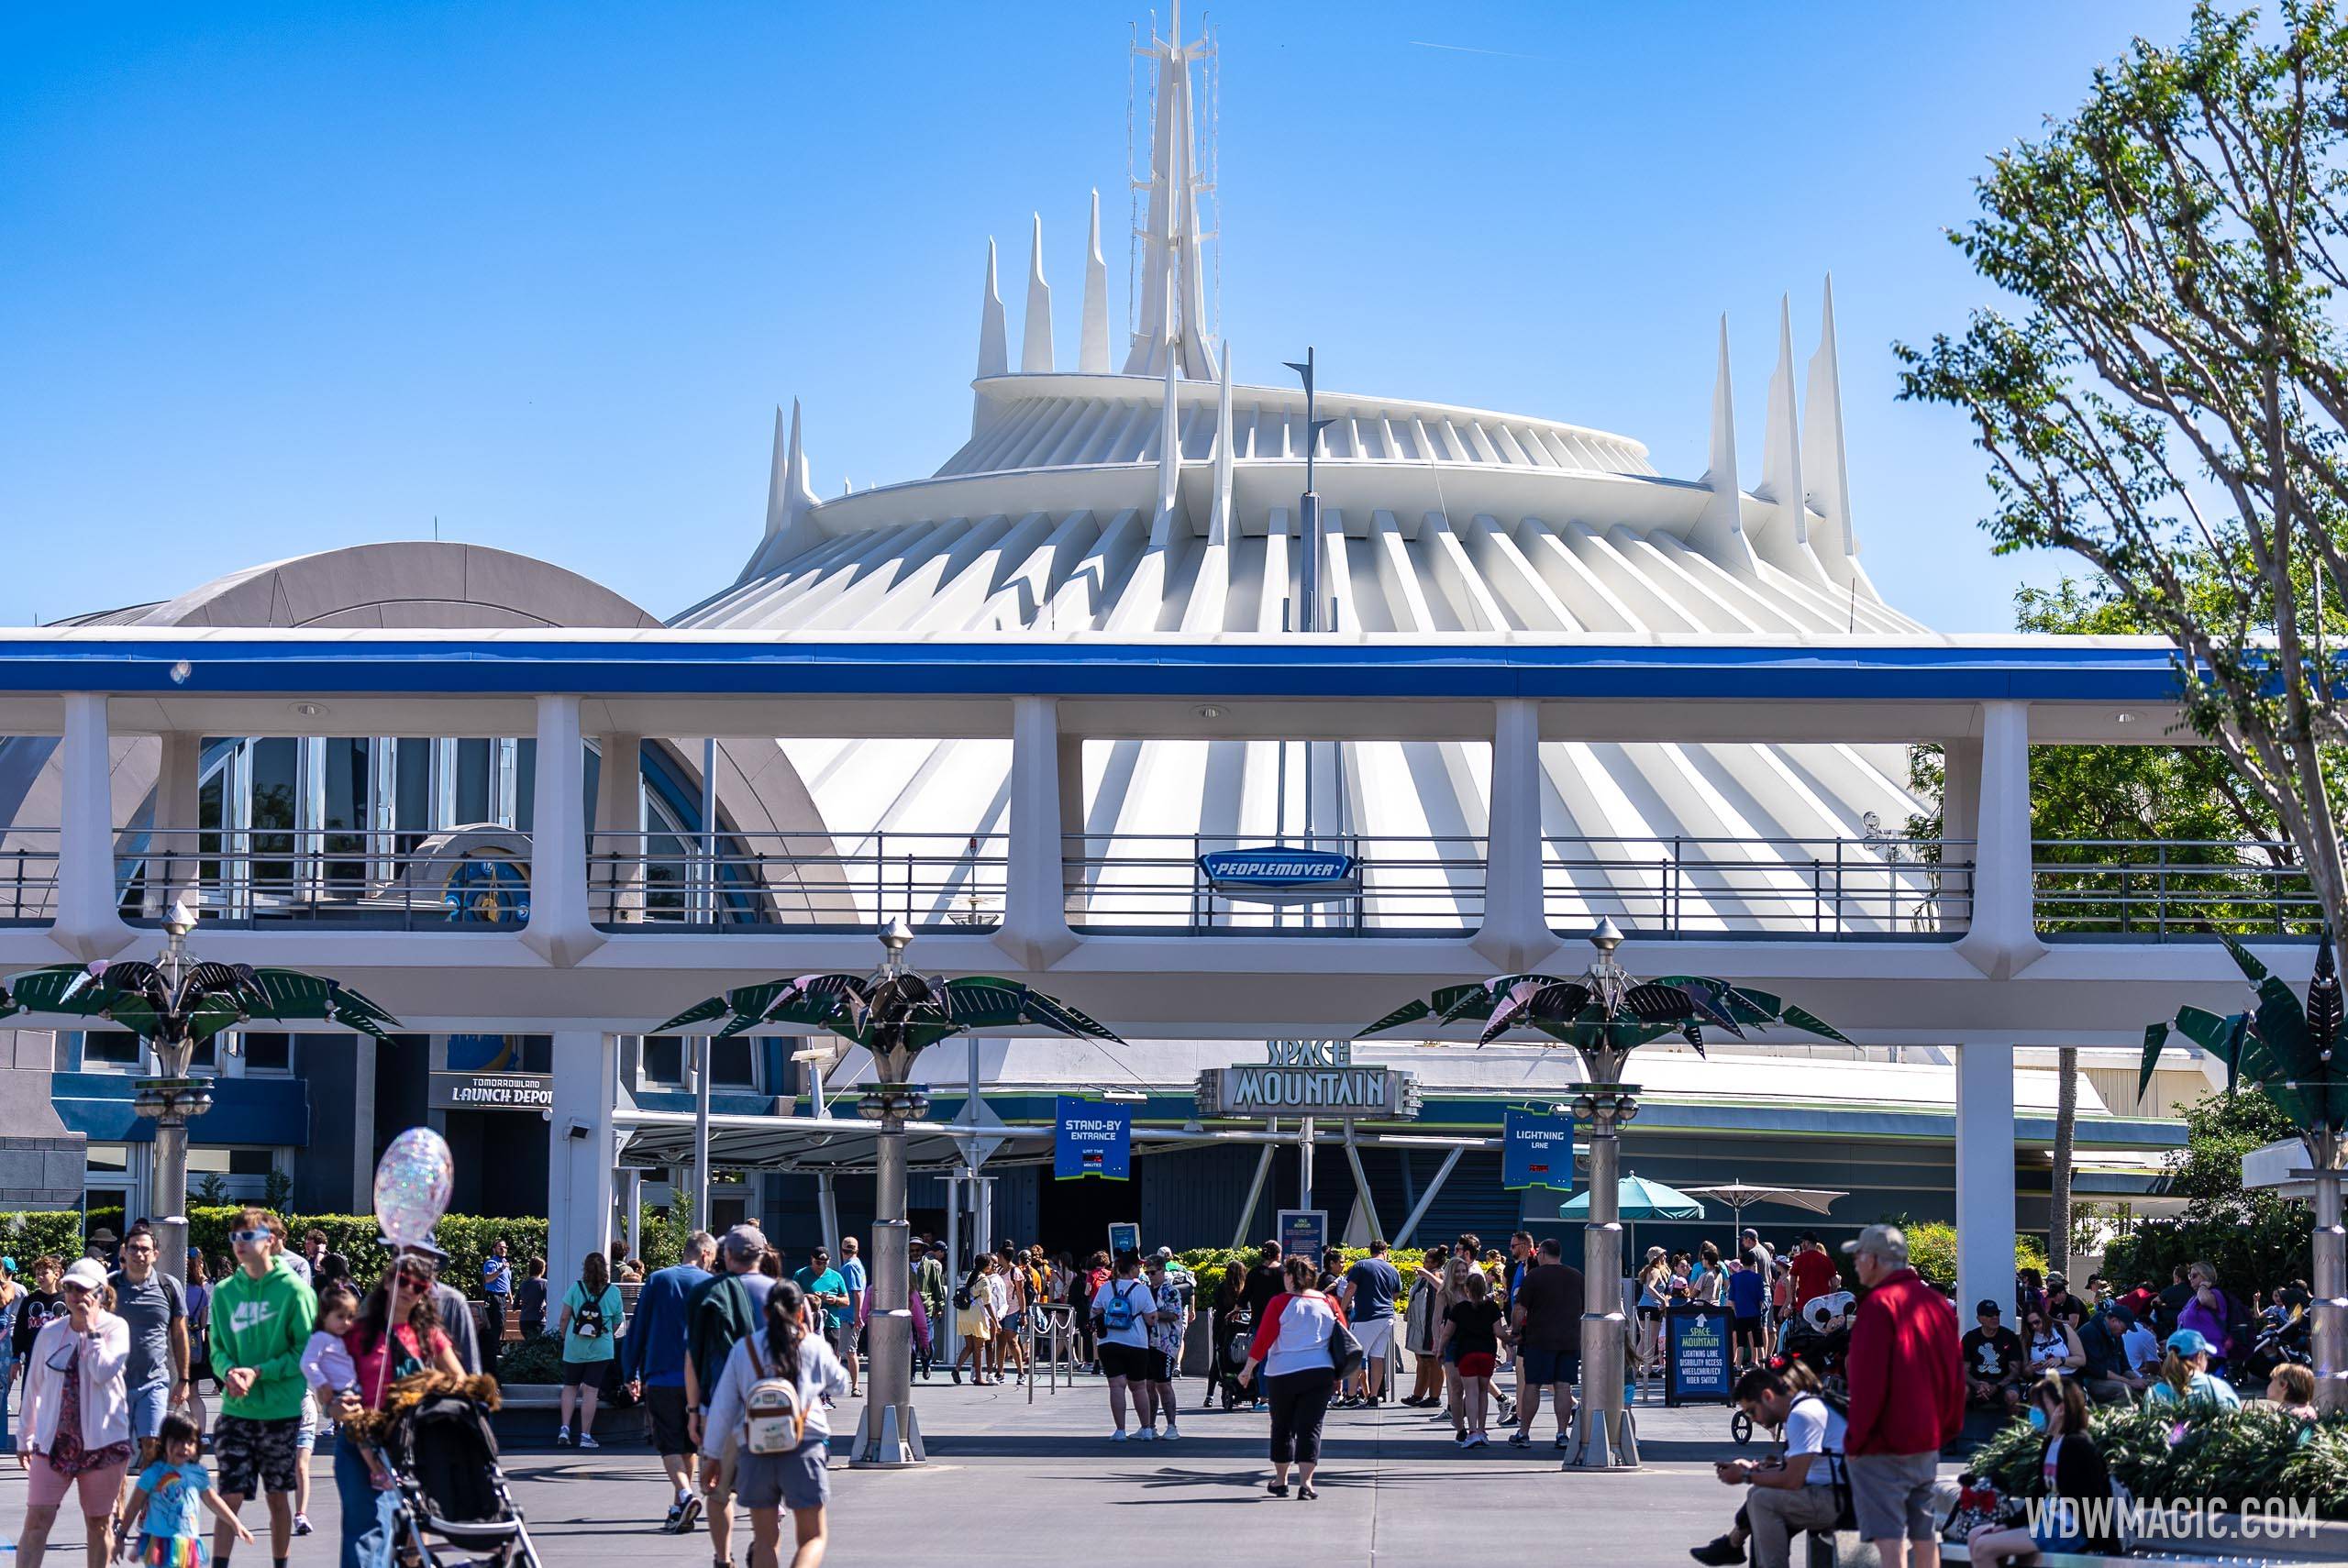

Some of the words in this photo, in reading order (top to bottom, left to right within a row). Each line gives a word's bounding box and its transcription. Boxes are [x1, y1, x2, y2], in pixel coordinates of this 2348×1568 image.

[1215, 863, 1335, 876] PEOPLEMOVER
[1267, 1040, 1351, 1066] SPACE
[472, 1078, 540, 1088] TOMORROWLAND
[1234, 1069, 1385, 1107] MOUNTAIN
[451, 1088, 511, 1102] LAUNCH
[1065, 1120, 1122, 1131] STAND-BY
[1070, 1132, 1116, 1141] ENTRANCE
[1516, 1131, 1564, 1140] LIGHTNING
[1689, 1327, 1711, 1336] SPACE
[1682, 1337, 1719, 1347] MOUNTAIN
[1682, 1350, 1706, 1358] LIGHTNING
[1706, 1350, 1719, 1358] LANE
[1686, 1376, 1700, 1385] RIDER
[1700, 1376, 1718, 1385] SWITCH
